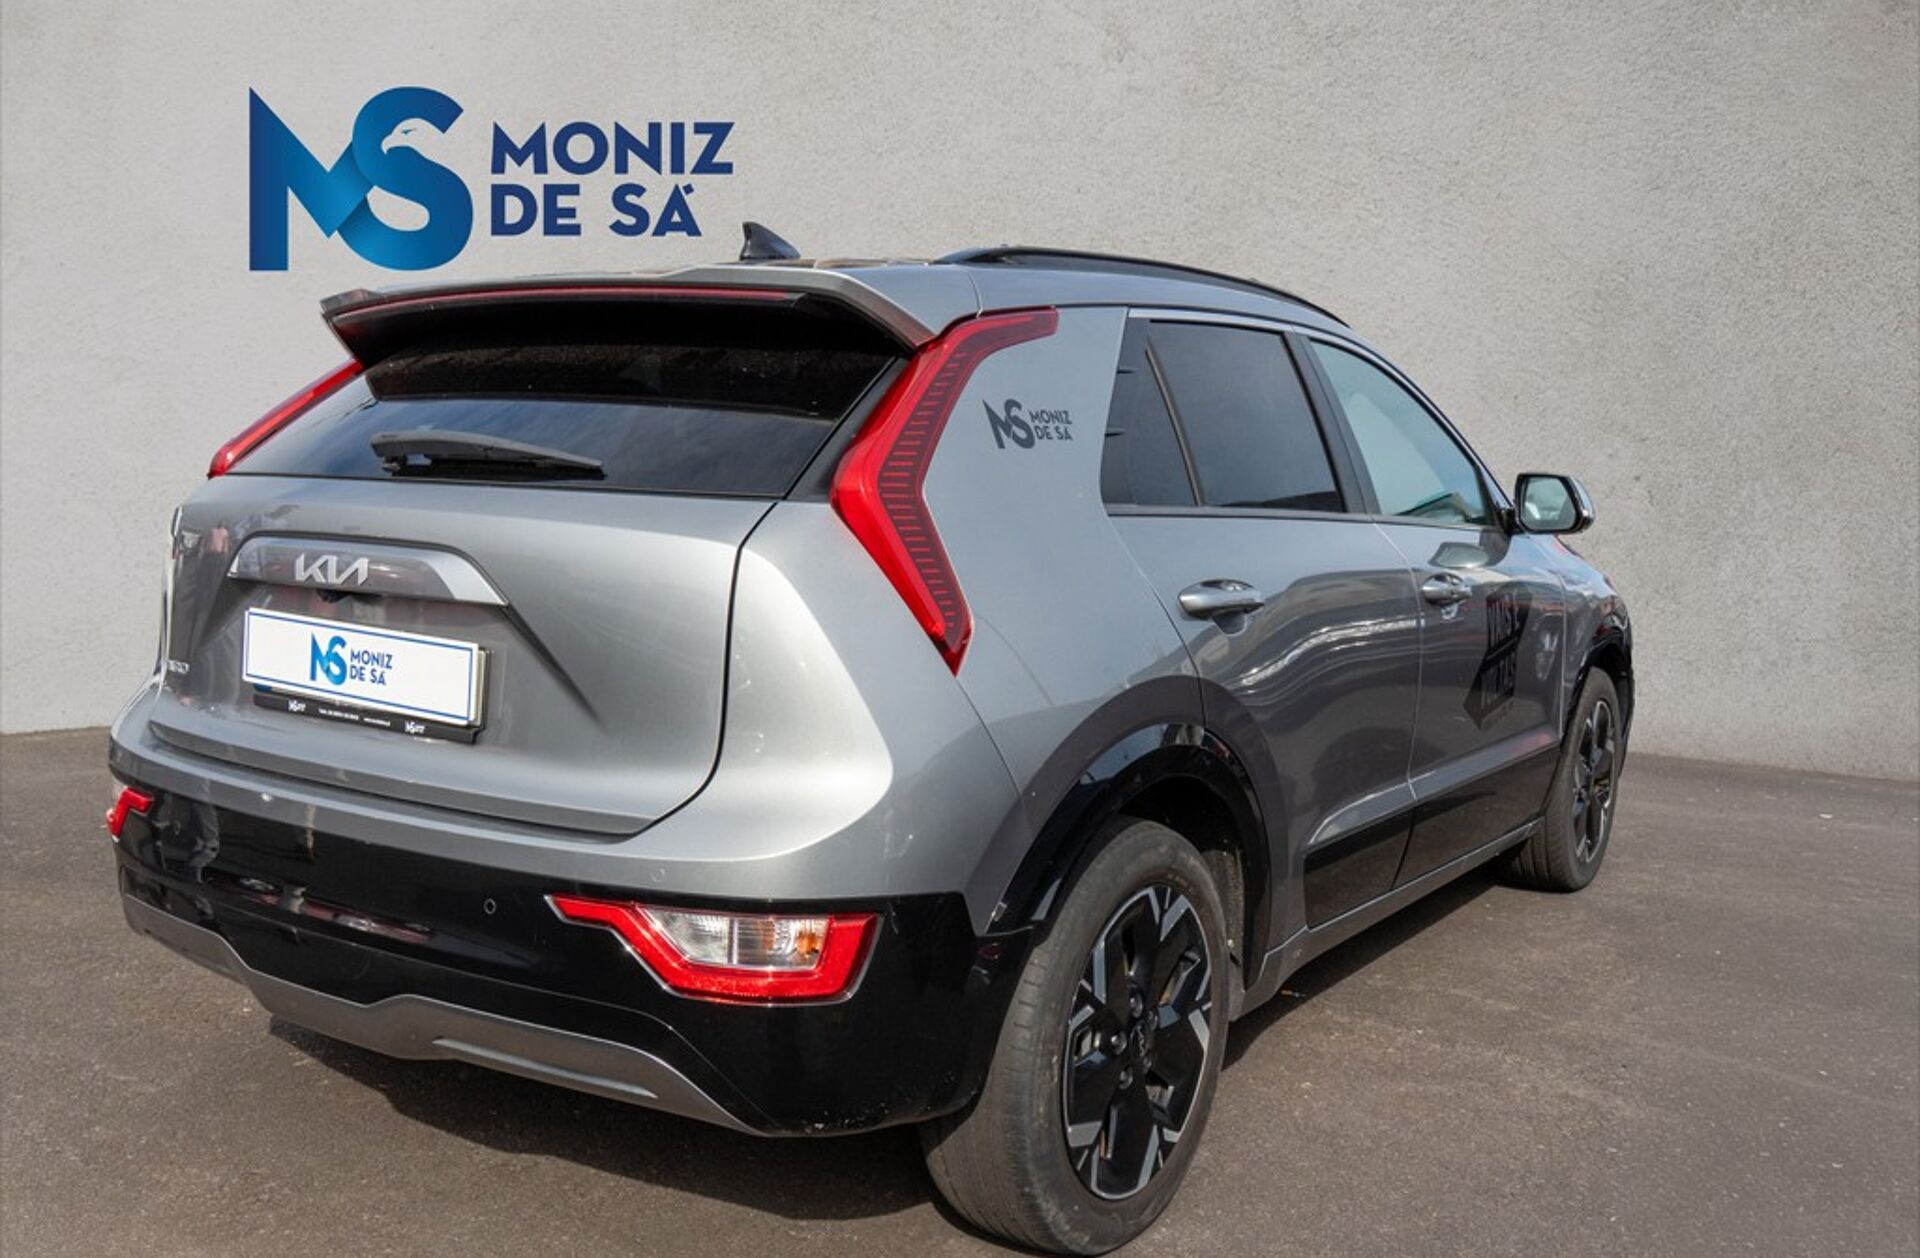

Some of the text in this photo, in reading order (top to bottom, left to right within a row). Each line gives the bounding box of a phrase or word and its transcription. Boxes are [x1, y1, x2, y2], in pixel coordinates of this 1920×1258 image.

[1029, 410, 1072, 425] MONIZ
[1034, 425, 1053, 440] DE
[295, 553, 369, 586] KIA
[351, 649, 393, 670] MONIZ
[350, 664, 365, 681] DE
